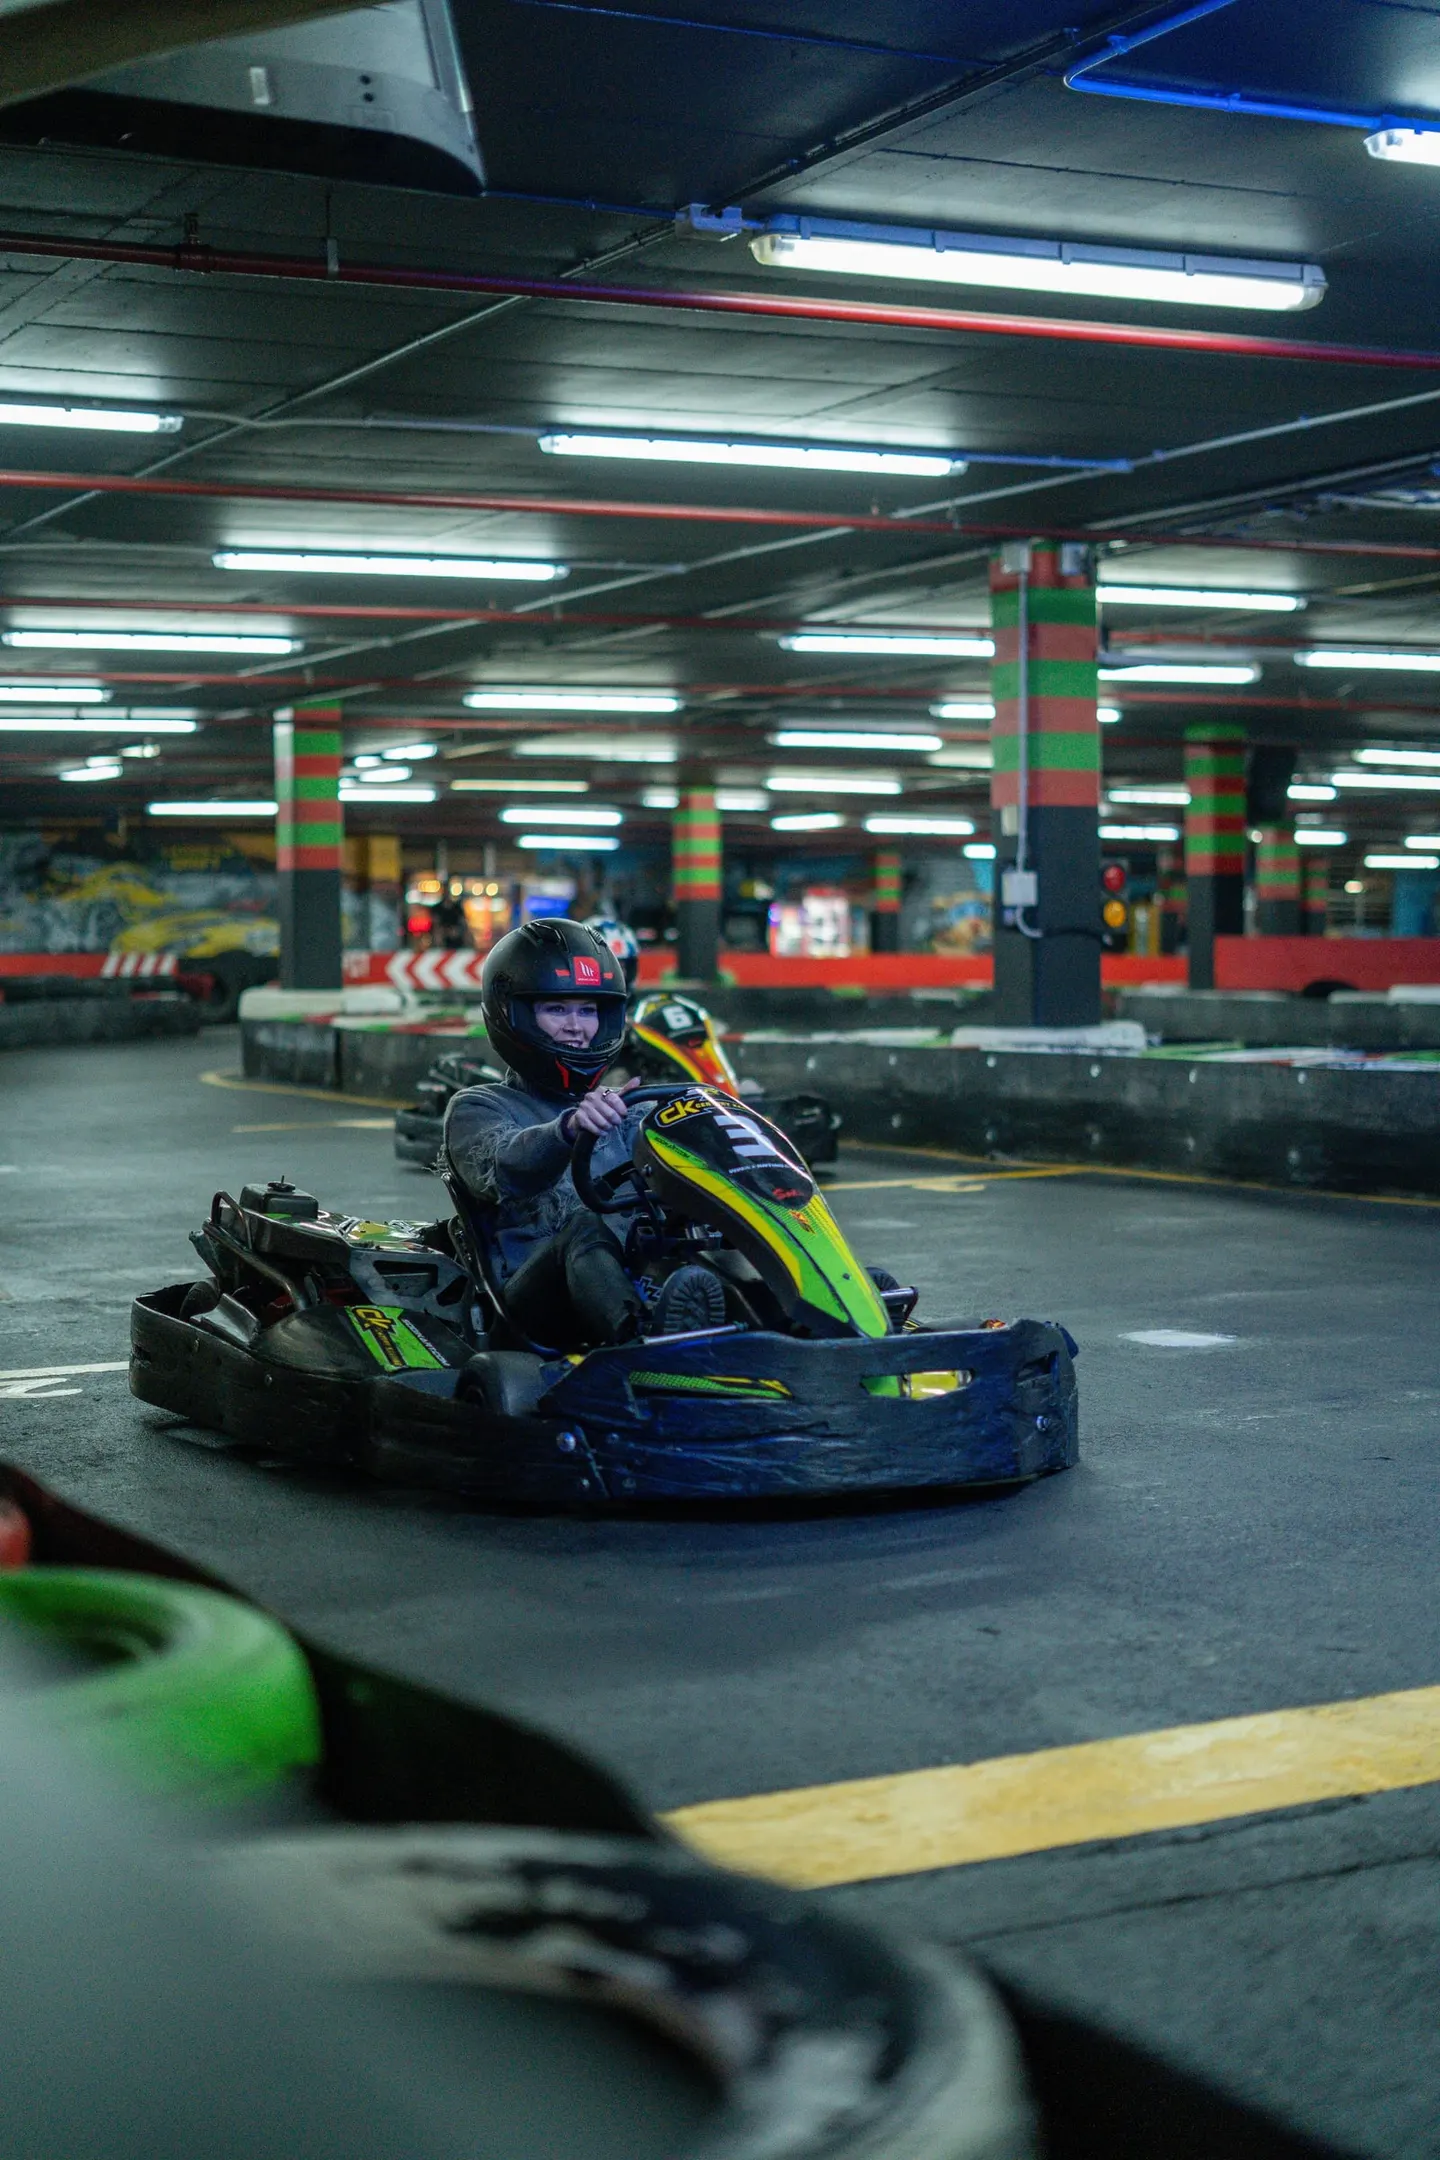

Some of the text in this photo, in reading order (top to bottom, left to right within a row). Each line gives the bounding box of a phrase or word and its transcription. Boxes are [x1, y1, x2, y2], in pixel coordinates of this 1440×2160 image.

[662, 1004, 694, 1030] 6
[660, 1099, 701, 1125] CK
[713, 1115, 777, 1157] 3
[355, 1308, 392, 1330] CK
